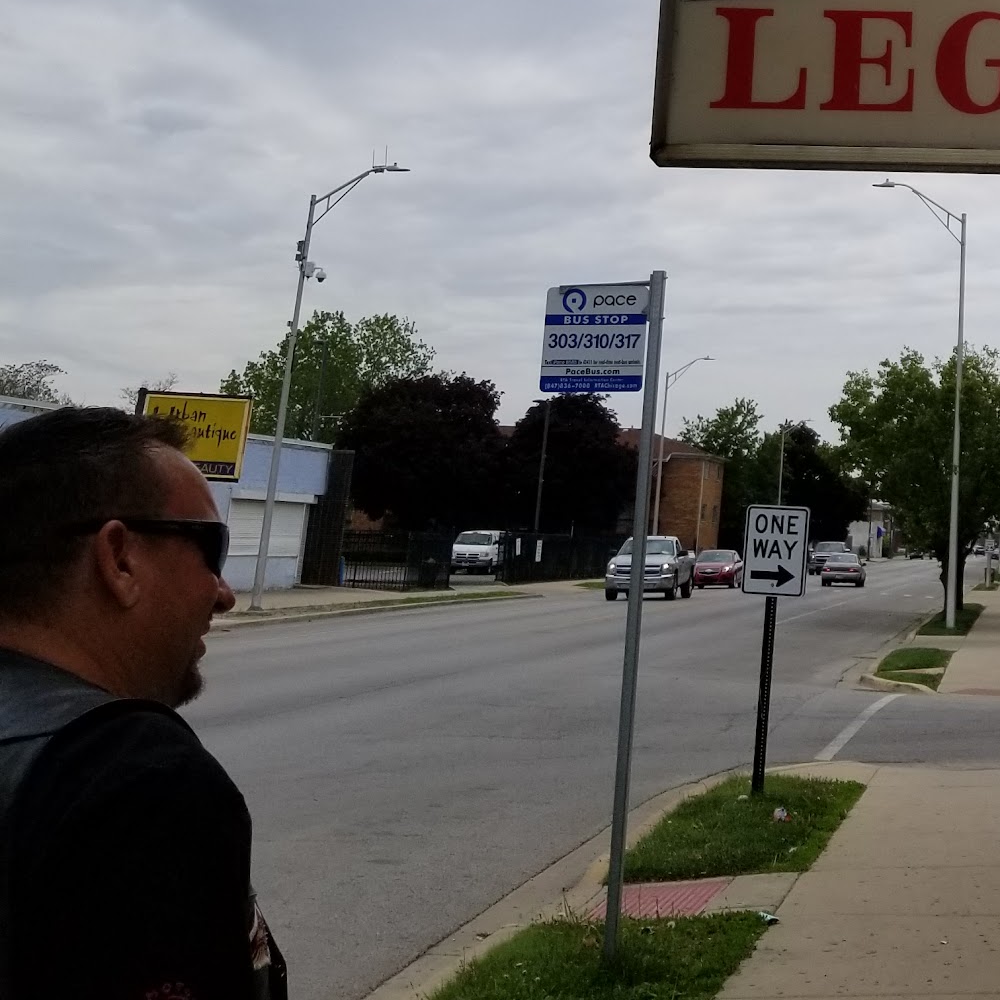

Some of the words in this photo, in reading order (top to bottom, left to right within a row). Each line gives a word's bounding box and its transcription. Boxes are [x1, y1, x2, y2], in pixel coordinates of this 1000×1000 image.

[593, 295, 637, 308] pace
[563, 315, 590, 325] BUS
[594, 315, 629, 324] STOP
[548, 333, 641, 349] 303/310/317
[565, 367, 620, 375] PaceBus.com
[755, 513, 799, 535] ONE
[753, 538, 799, 560] WAY
